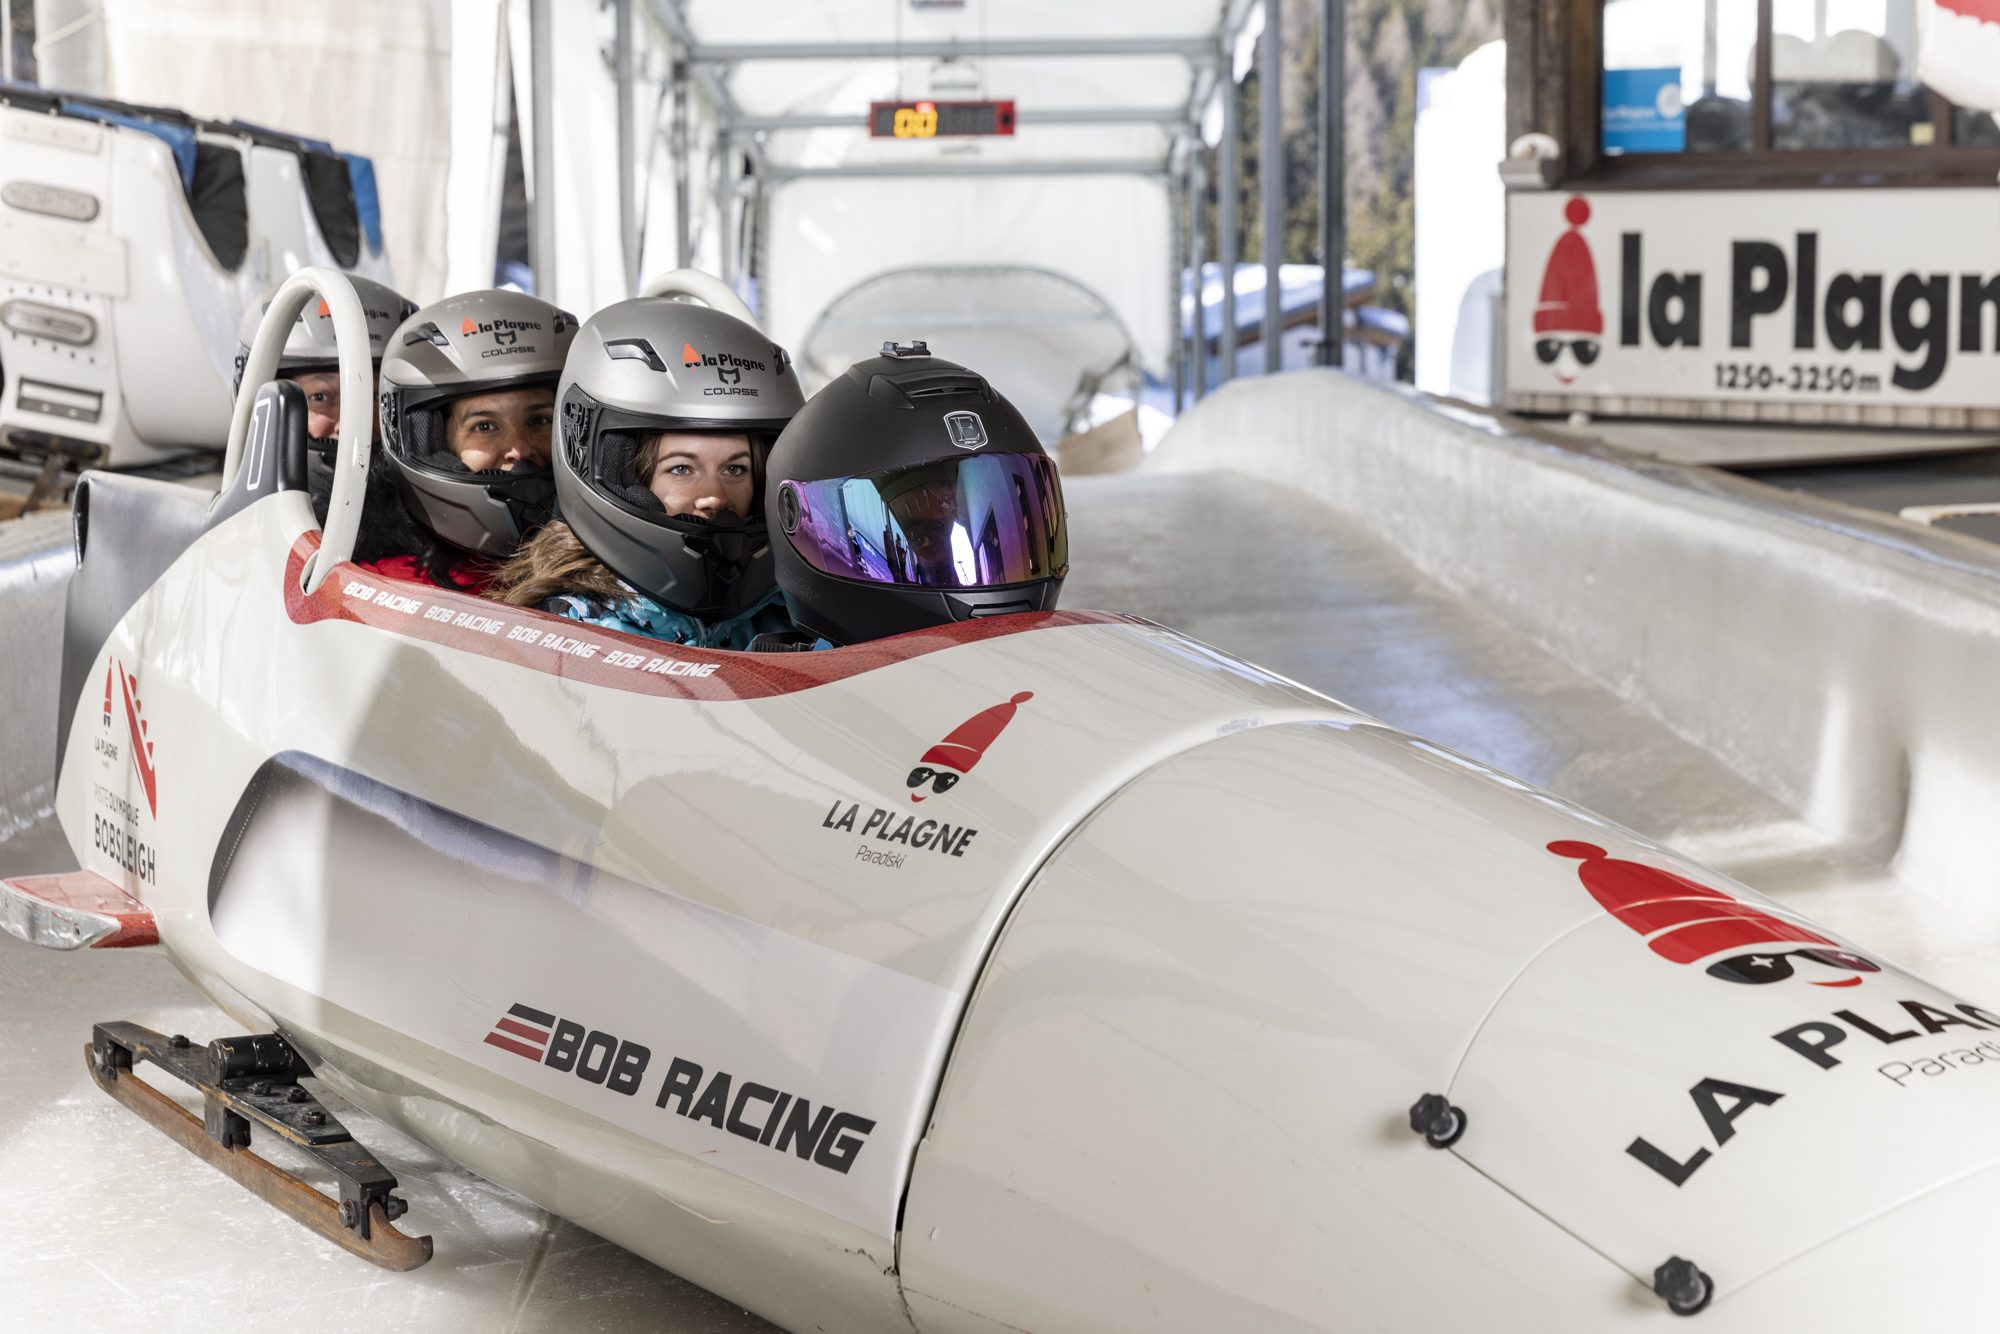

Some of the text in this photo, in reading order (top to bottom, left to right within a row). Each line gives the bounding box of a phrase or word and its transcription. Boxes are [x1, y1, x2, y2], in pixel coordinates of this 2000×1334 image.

[1619, 231, 1702, 347] la
[478, 319, 541, 333] la Plagne
[481, 346, 536, 358] COURSE
[701, 353, 766, 371] la Plagne
[703, 387, 759, 397] COURSE
[246, 397, 271, 491] 1
[343, 581, 721, 678] BOB RACING BOB RACING BOB RACING BOB RACING
[95, 812, 156, 886] BOBSLEIGH
[822, 800, 978, 858] LA PLAGNE
[544, 1018, 877, 1175] BOB RACING
[1878, 1040, 2000, 1087] Parad
[1625, 1077, 1786, 1187] LA
